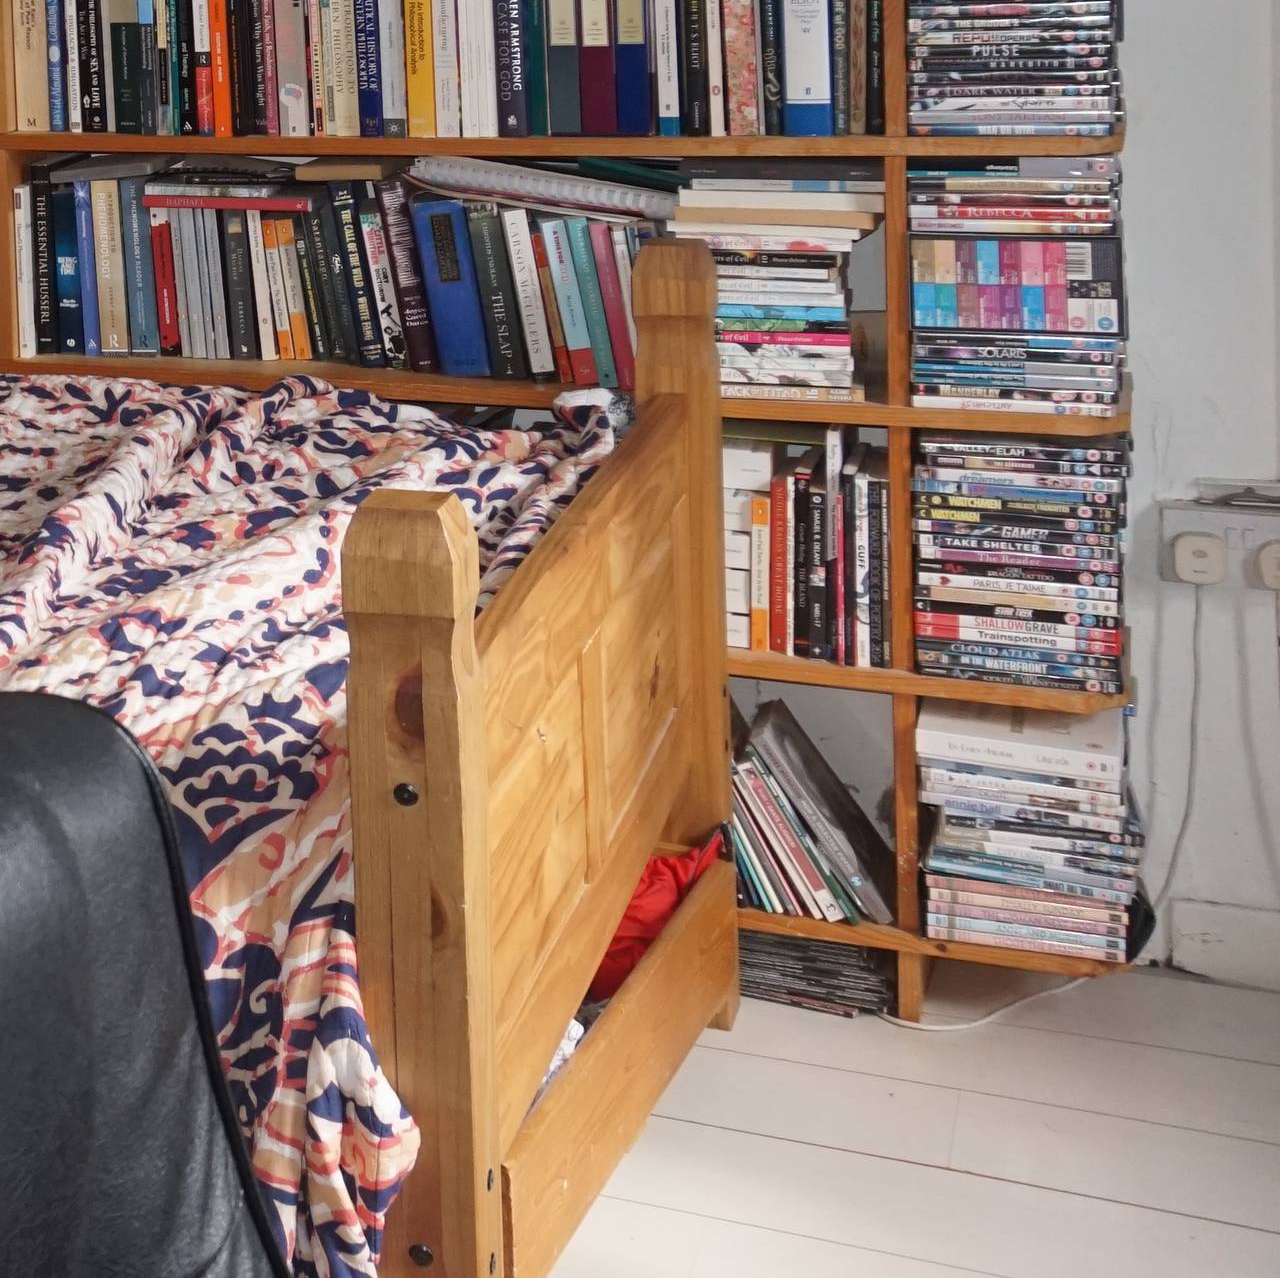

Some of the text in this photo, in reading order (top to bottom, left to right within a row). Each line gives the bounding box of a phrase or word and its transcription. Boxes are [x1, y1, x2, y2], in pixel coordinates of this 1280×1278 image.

[417, 12, 425, 51] Introduction
[510, 23, 521, 90] ARMSTRONG
[972, 45, 1020, 56] PULSE
[333, 29, 343, 93] PHILOSOPHY
[96, 192, 110, 279] PHENOMENOLOGY
[311, 219, 327, 280] Satantango
[36, 195, 49, 323] THE ESSENTIAL HUSSERL
[342, 210, 374, 339] THE CALL OF THE WILD WHITE FANG
[491, 292, 512, 358] THE SLAP
[978, 348, 1027, 359] SOLARIS
[948, 496, 1002, 510] WATCHMEN
[931, 509, 980, 522] WATCHMEN
[1002, 526, 1049, 539] GAMER
[945, 538, 1040, 552] TAKE SHELTER
[979, 554, 1040, 566] The Reader
[994, 607, 1032, 617] STAR TREK
[978, 630, 1057, 646] Trainspotting
[951, 644, 1040, 660] CLOUD ATLAS
